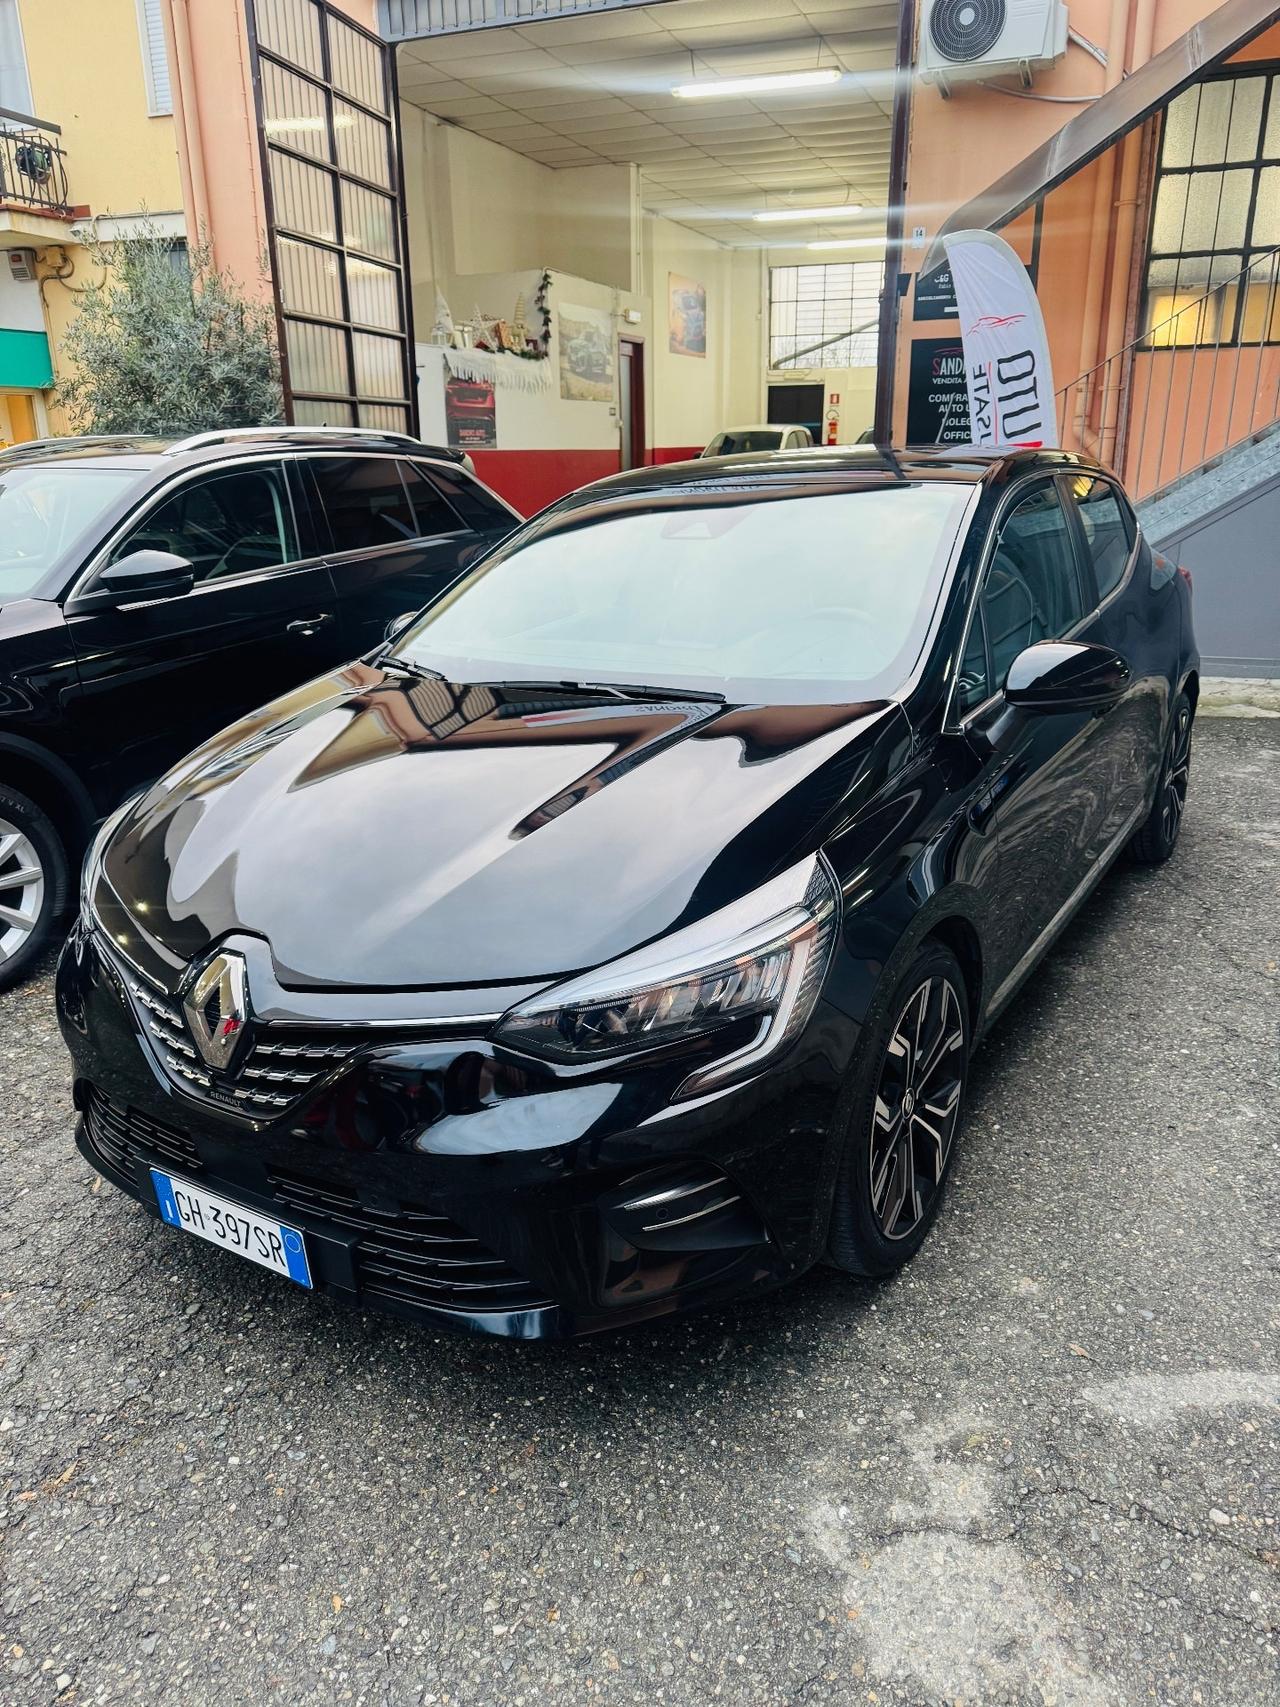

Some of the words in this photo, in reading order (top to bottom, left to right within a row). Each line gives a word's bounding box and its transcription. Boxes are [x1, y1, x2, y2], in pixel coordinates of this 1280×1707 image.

[932, 357, 966, 376] SAND
[932, 377, 962, 385] VENDITA
[210, 1091, 240, 1107] RENAULT
